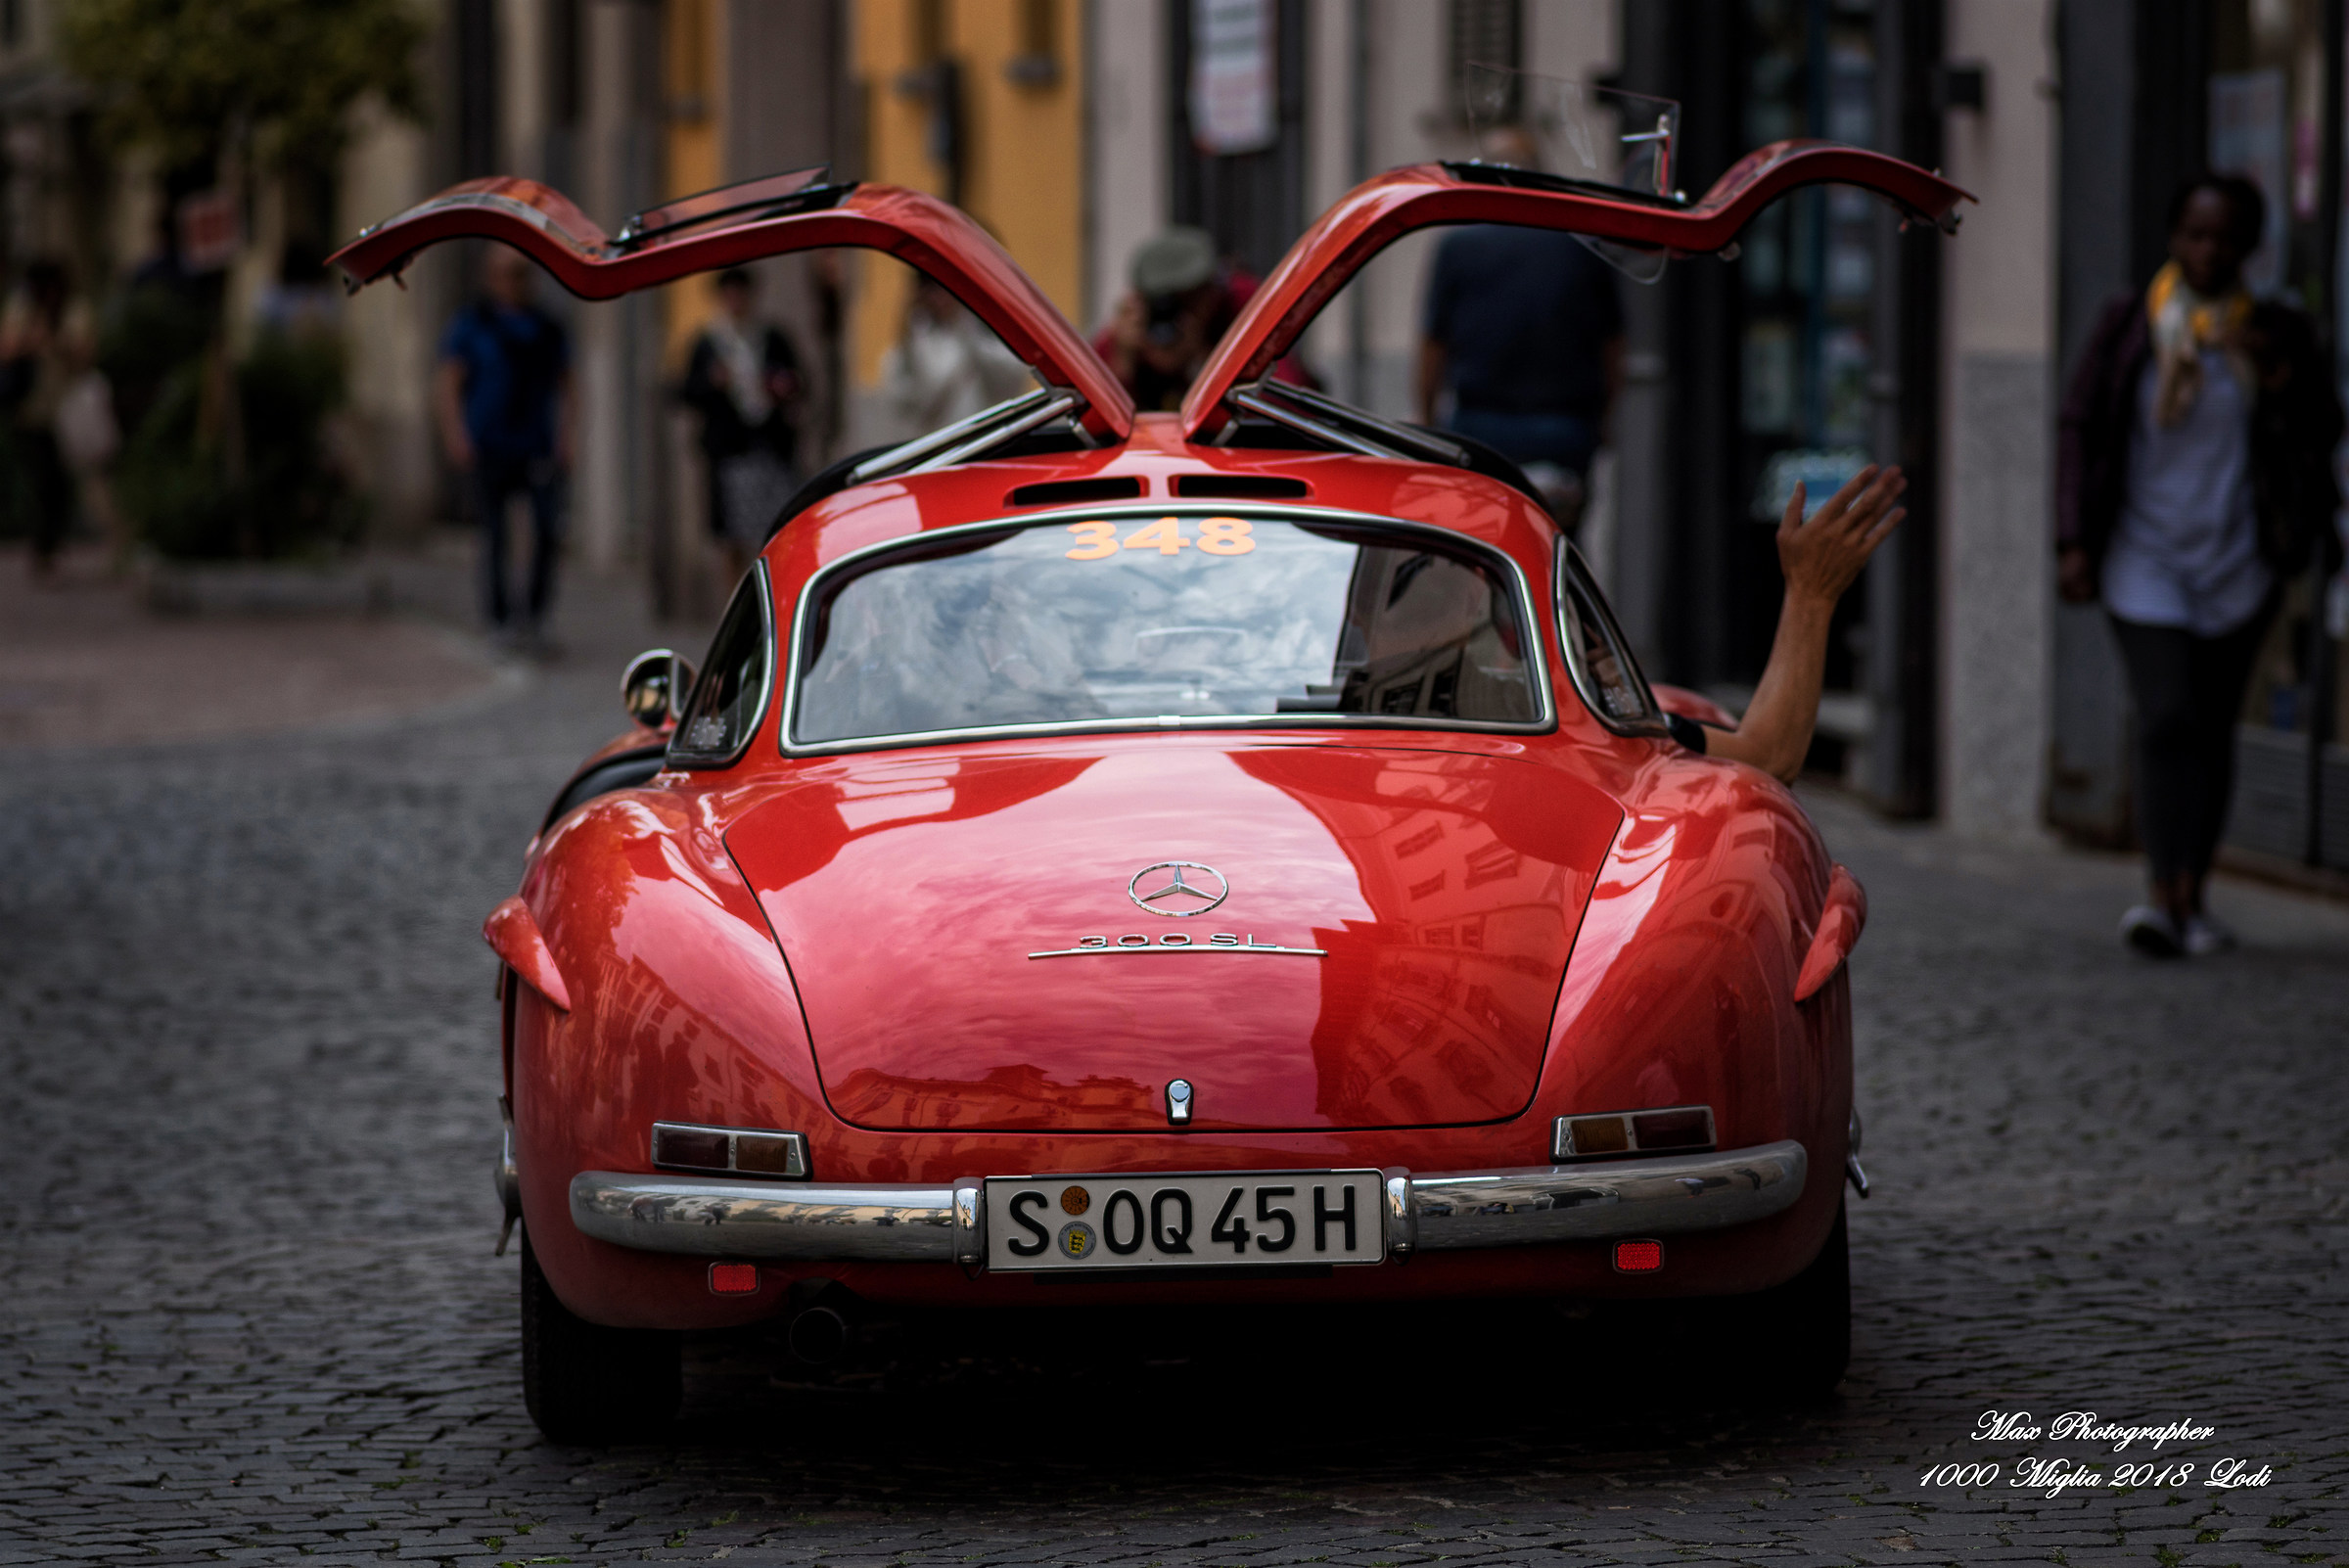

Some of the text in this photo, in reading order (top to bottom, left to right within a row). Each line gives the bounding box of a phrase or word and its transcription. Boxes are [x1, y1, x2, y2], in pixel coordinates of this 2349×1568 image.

[1066, 517, 1257, 561] 348
[1080, 934, 1276, 948] 300 SL
[1008, 1190, 1050, 1258] S
[1102, 1188, 1193, 1257] OQ
